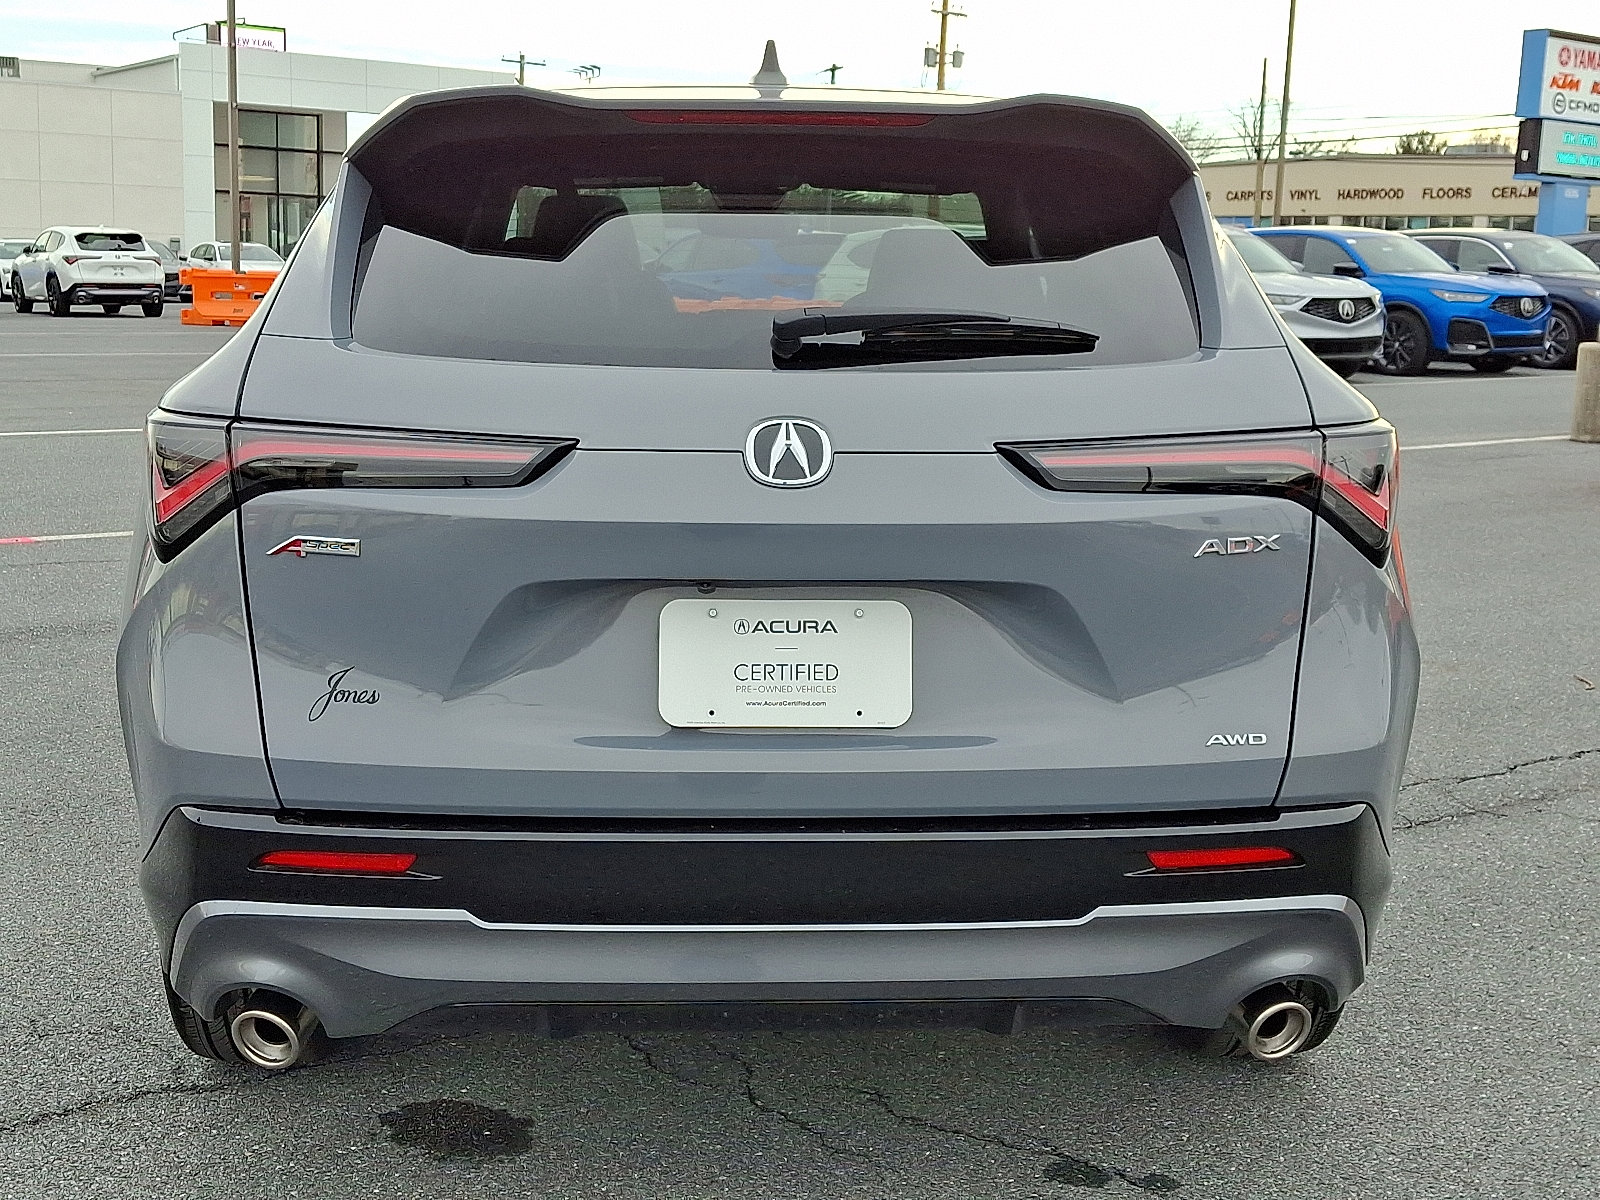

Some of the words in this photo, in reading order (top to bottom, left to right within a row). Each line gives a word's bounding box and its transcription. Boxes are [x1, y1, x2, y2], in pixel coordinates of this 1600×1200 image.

[1550, 73, 1580, 91] KTM
[1226, 190, 1274, 201] CARPTS
[1290, 189, 1321, 201] VINYL
[1337, 188, 1404, 200] HARDWOOD
[1422, 187, 1472, 199] FLOORS
[1194, 534, 1281, 558] ADX
[751, 620, 839, 634] ACURA
[734, 663, 839, 681] CERTIFIED
[308, 665, 380, 722] Jones
[735, 685, 794, 694] PRE-OWNED
[795, 685, 837, 694] VEHICLES
[1205, 732, 1267, 746] AWD
